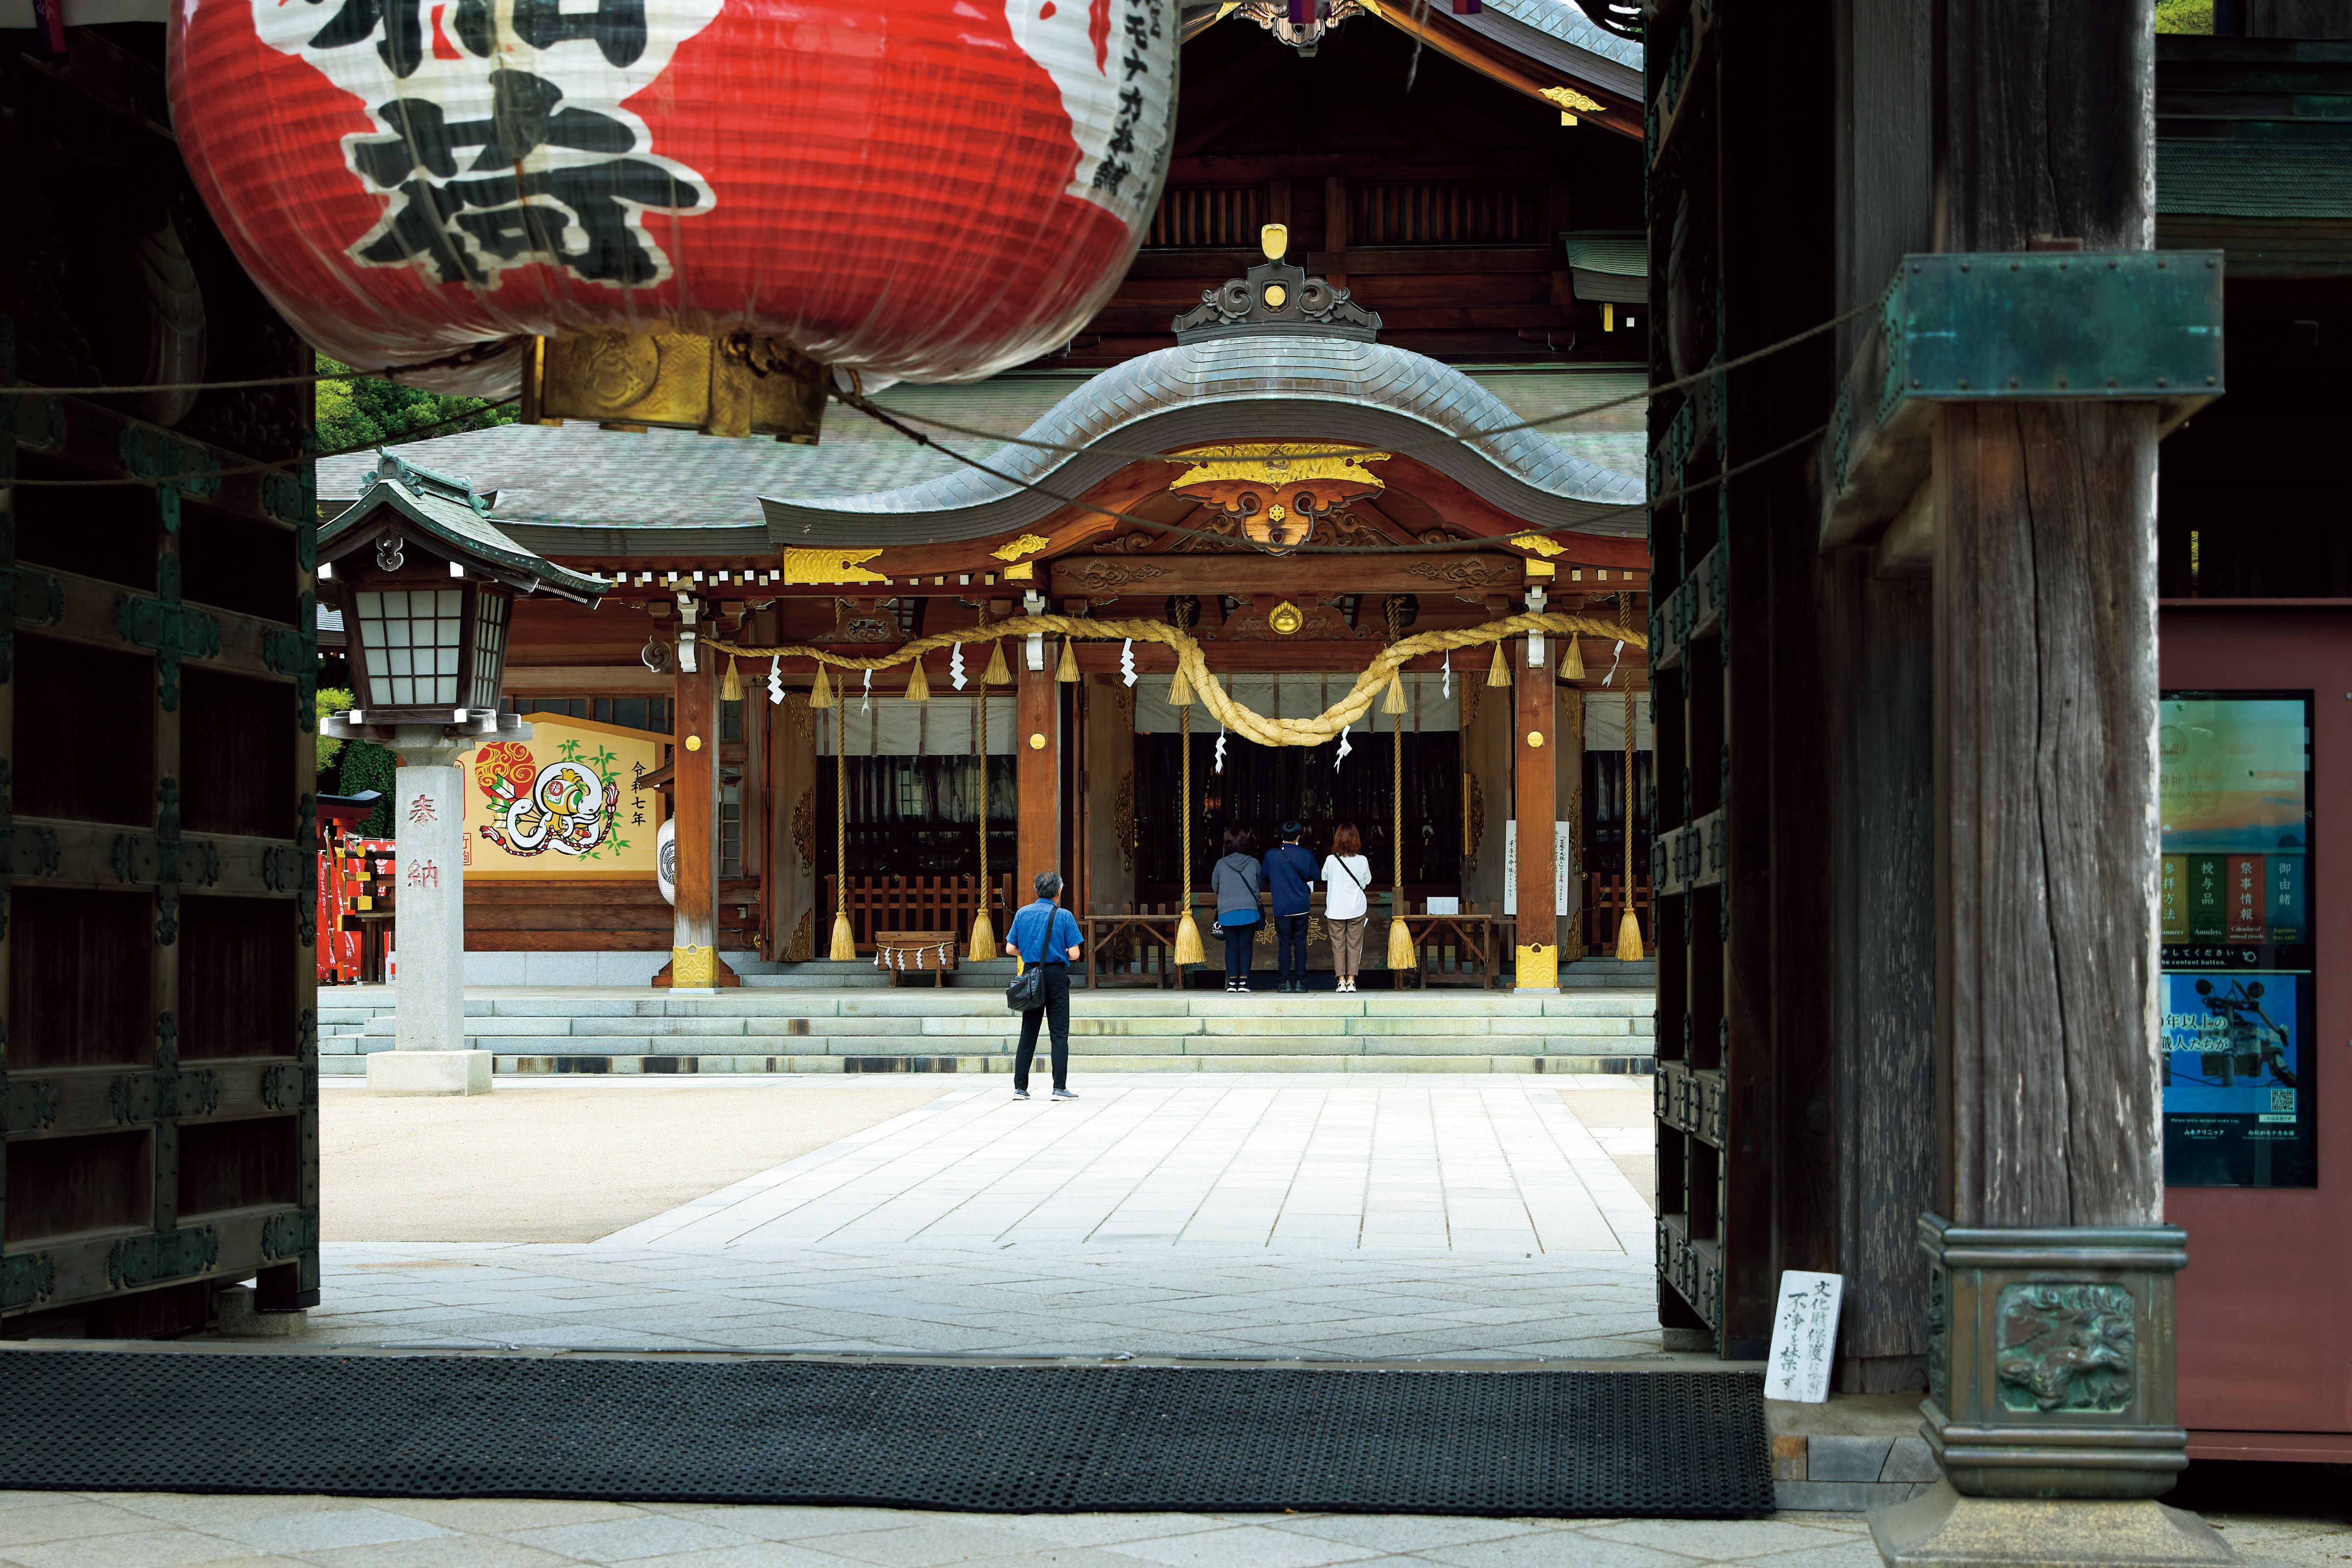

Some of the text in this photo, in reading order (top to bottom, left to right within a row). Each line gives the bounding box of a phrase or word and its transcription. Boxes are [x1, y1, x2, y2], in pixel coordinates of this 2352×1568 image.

[1093, 0, 1149, 196] モナカ本舗
[551, 783, 561, 794] 福
[631, 761, 646, 827] 令和七年
[409, 794, 438, 888] 奉納
[2163, 861, 2175, 920] 参拝方法
[2201, 861, 2214, 905] 授与品
[2240, 862, 2253, 920] 祭事情報
[2278, 862, 2291, 906] 御由緒
[2161, 1014, 2226, 1029] 年以上の
